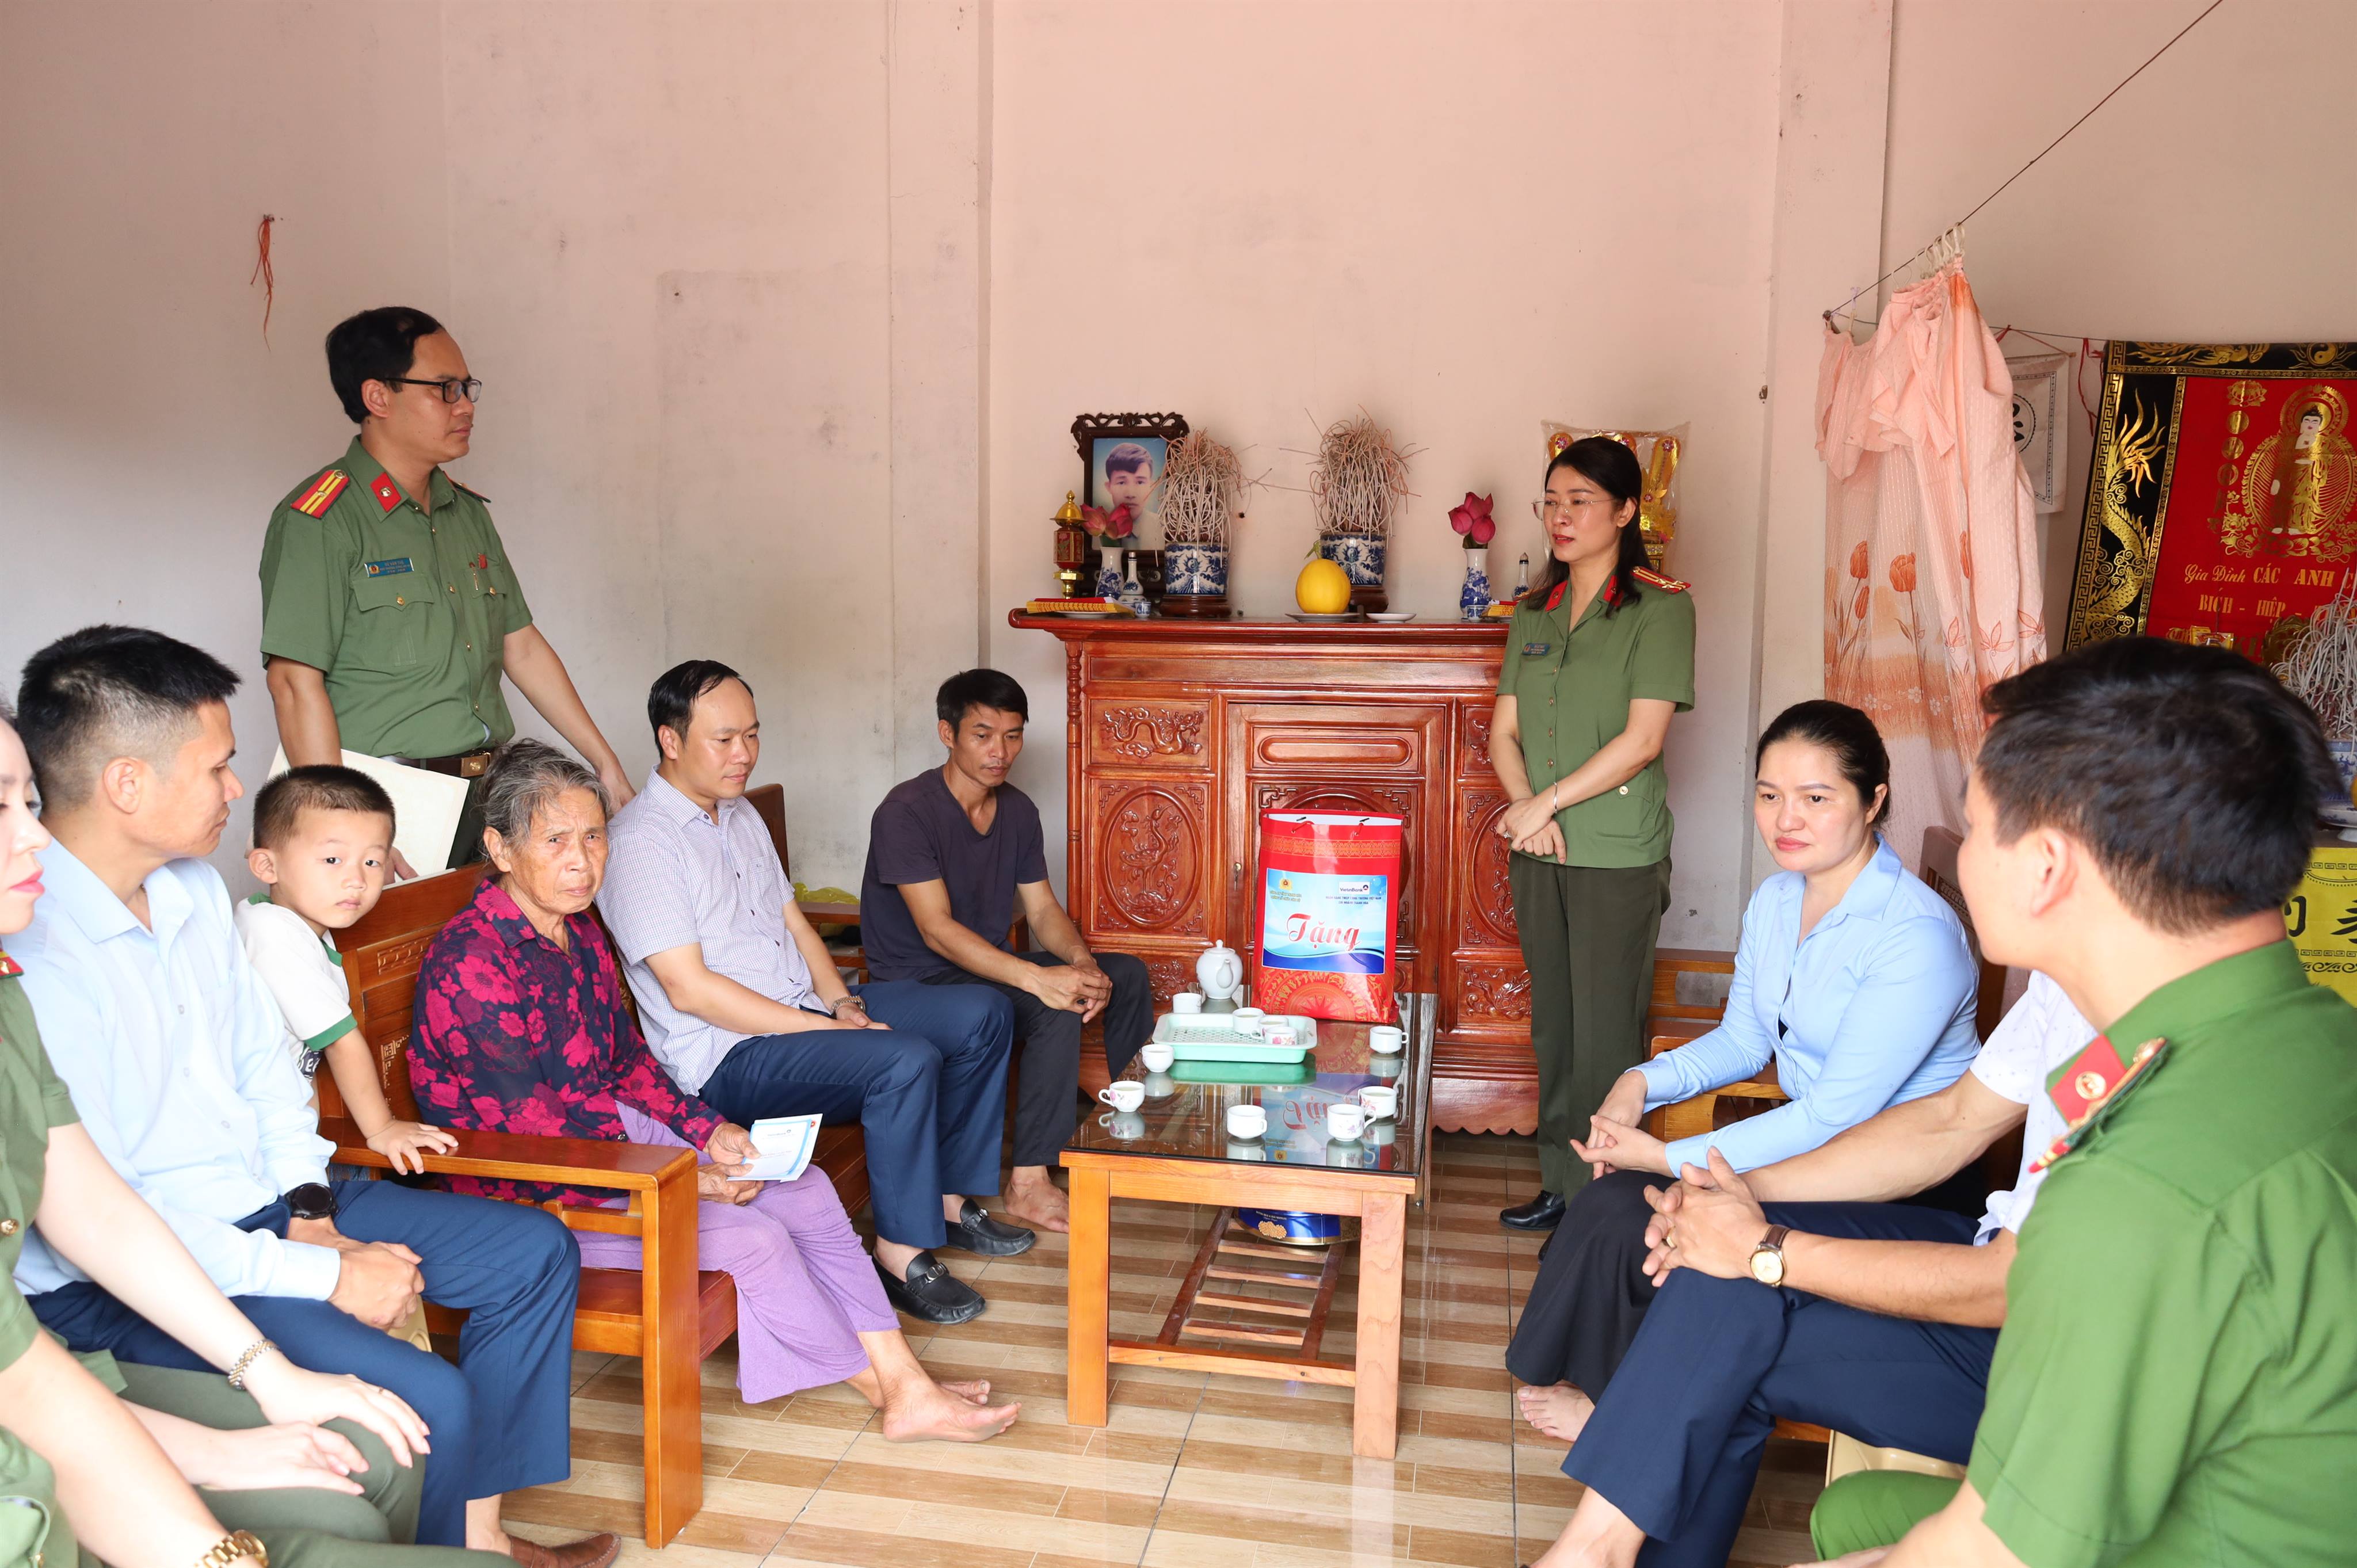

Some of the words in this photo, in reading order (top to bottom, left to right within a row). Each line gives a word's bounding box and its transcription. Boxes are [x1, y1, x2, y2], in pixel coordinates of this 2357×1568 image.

[2184, 564, 2209, 583] Gia
[2253, 563, 2280, 583] CÁC
[2294, 569, 2335, 586] ANH
[2256, 597, 2286, 623] HIỆP
[1287, 913, 1361, 951] Tặng
